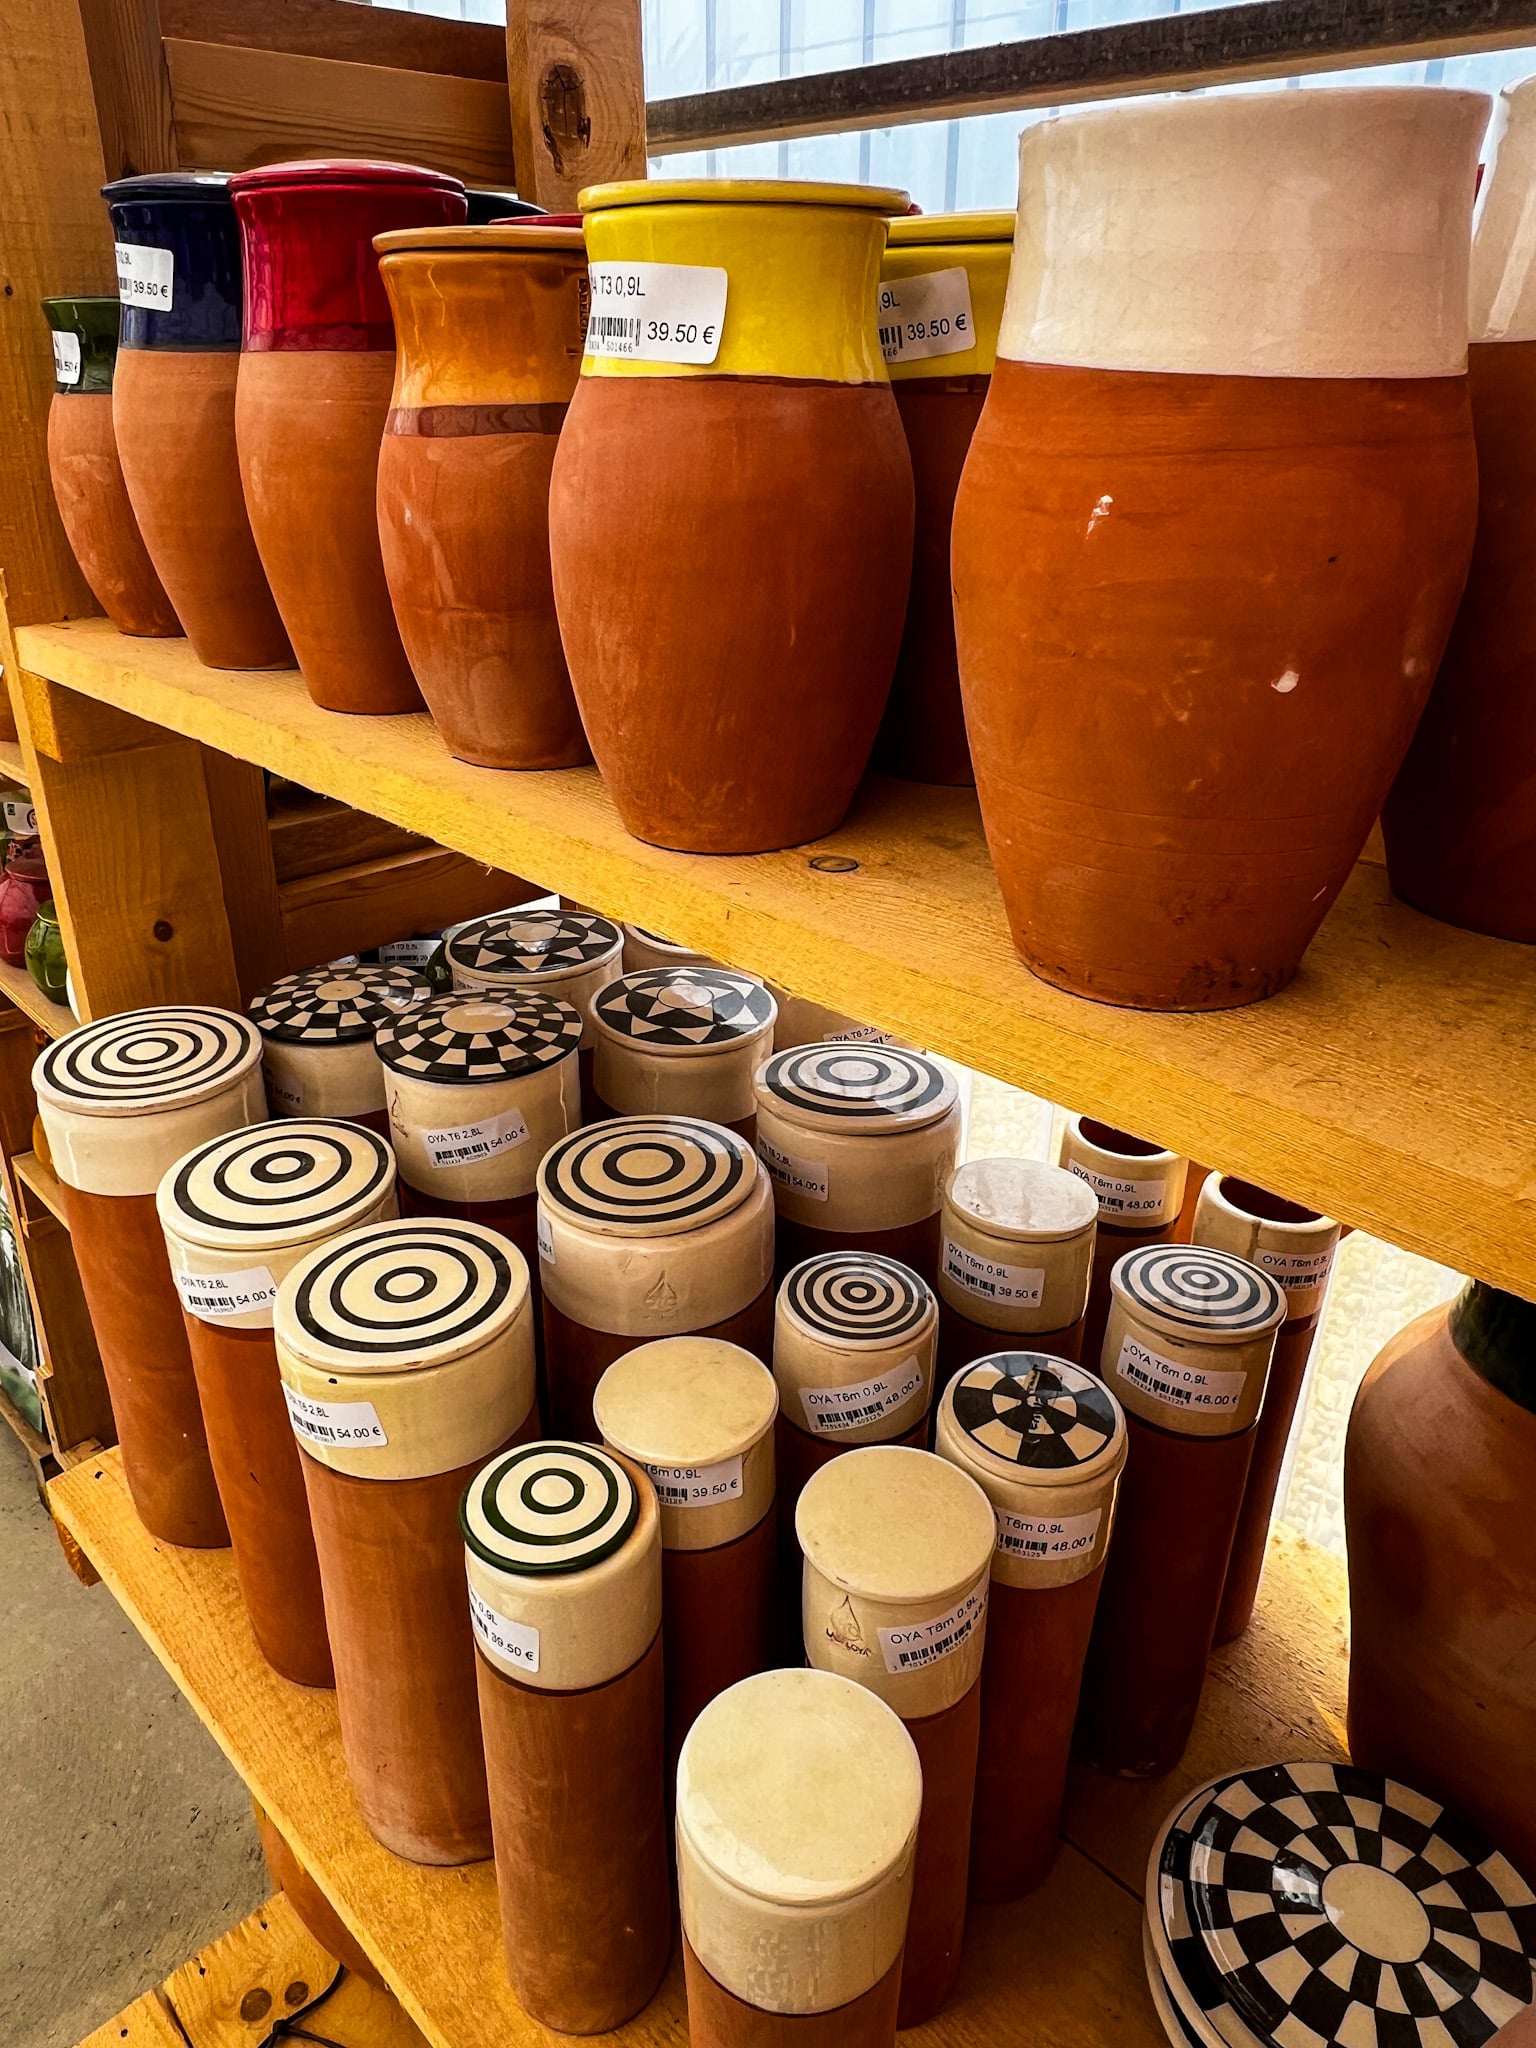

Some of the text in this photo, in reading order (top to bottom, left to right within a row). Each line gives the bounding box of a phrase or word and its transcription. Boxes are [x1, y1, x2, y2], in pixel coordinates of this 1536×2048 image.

[133, 280, 168, 297] 39.50 €
[600, 275, 612, 295] T3
[615, 276, 646, 298] 0,9L
[879, 291, 901, 312] ,9L
[647, 321, 715, 344] 39.50 €
[907, 313, 967, 340] 39.50 €
[427, 1134, 448, 1144] OYA
[447, 1131, 461, 1141] T6
[490, 1126, 526, 1148] 54.00 €
[792, 1177, 826, 1193] 54.00 €
[1073, 1166, 1090, 1182] OYA
[1092, 1175, 1113, 1189] T6m
[1126, 1200, 1155, 1209] 48.00
[948, 1243, 963, 1259] OYA
[964, 1254, 984, 1270] T6m
[1262, 1255, 1287, 1267] OYA
[1291, 1259, 1312, 1267] T6m
[236, 1287, 276, 1305] 54.00 €
[1031, 1290, 1039, 1299] €
[1130, 1345, 1151, 1366] OYA
[1154, 1359, 1180, 1378] T6m
[808, 1394, 834, 1405] OYA
[834, 1391, 861, 1403] T6m
[885, 1380, 914, 1405] 48.00
[1194, 1394, 1230, 1405] 48.00
[336, 1428, 370, 1438] 54.00
[372, 1426, 381, 1435] €
[643, 1462, 669, 1477] T6m
[692, 1478, 738, 1498] 39.50 €
[1004, 1515, 1034, 1532] T6m
[1051, 1537, 1087, 1552] 48.00
[890, 1631, 923, 1644] OYA
[925, 1617, 955, 1637] T6m
[490, 1632, 534, 1661] 39.50 €
